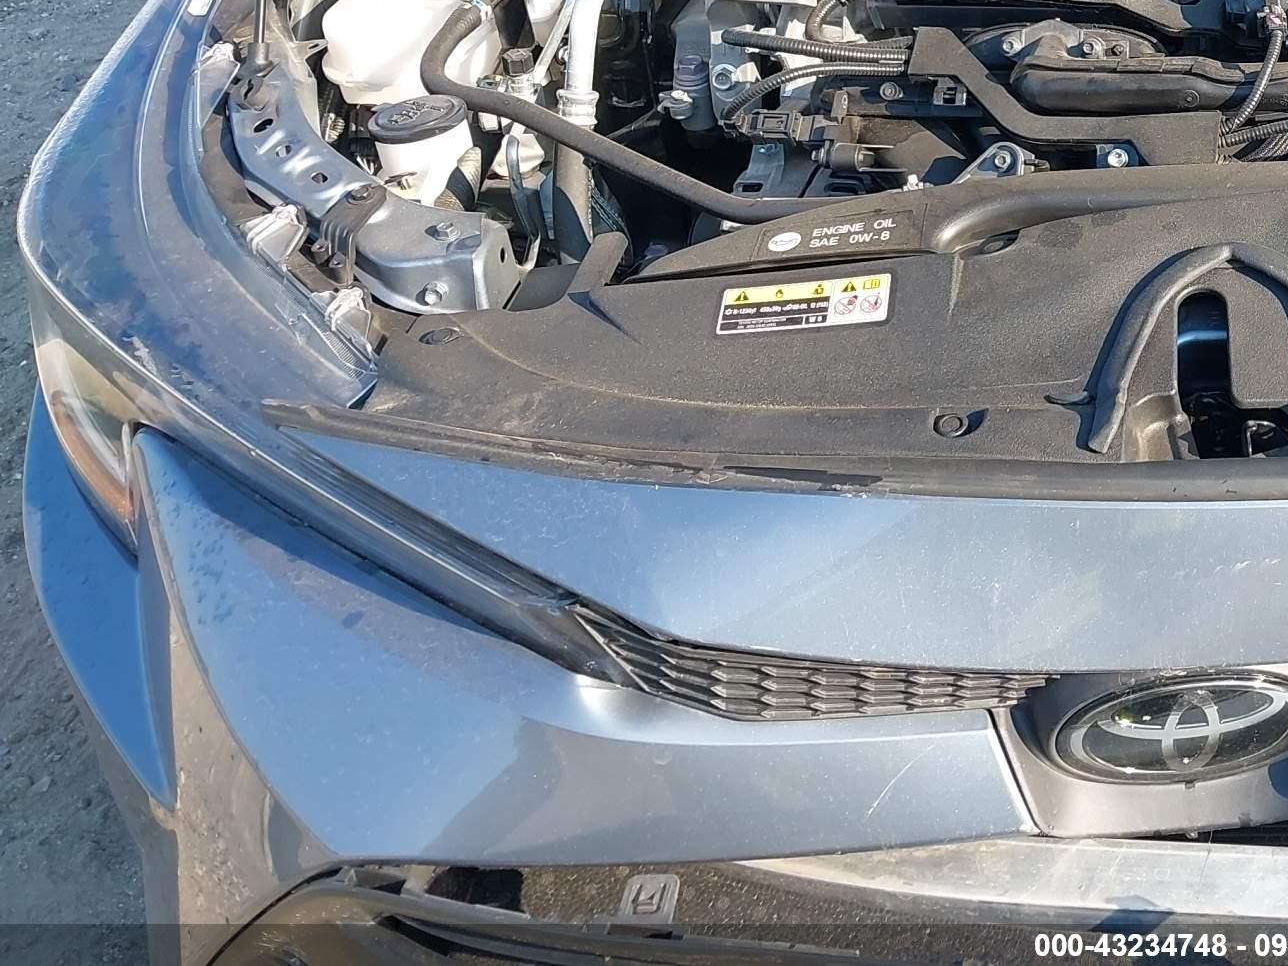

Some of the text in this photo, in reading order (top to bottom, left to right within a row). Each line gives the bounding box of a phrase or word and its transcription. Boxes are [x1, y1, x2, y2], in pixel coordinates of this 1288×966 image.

[812, 218, 897, 238] ENGINE OIL
[809, 230, 890, 248] SAE 0W-8
